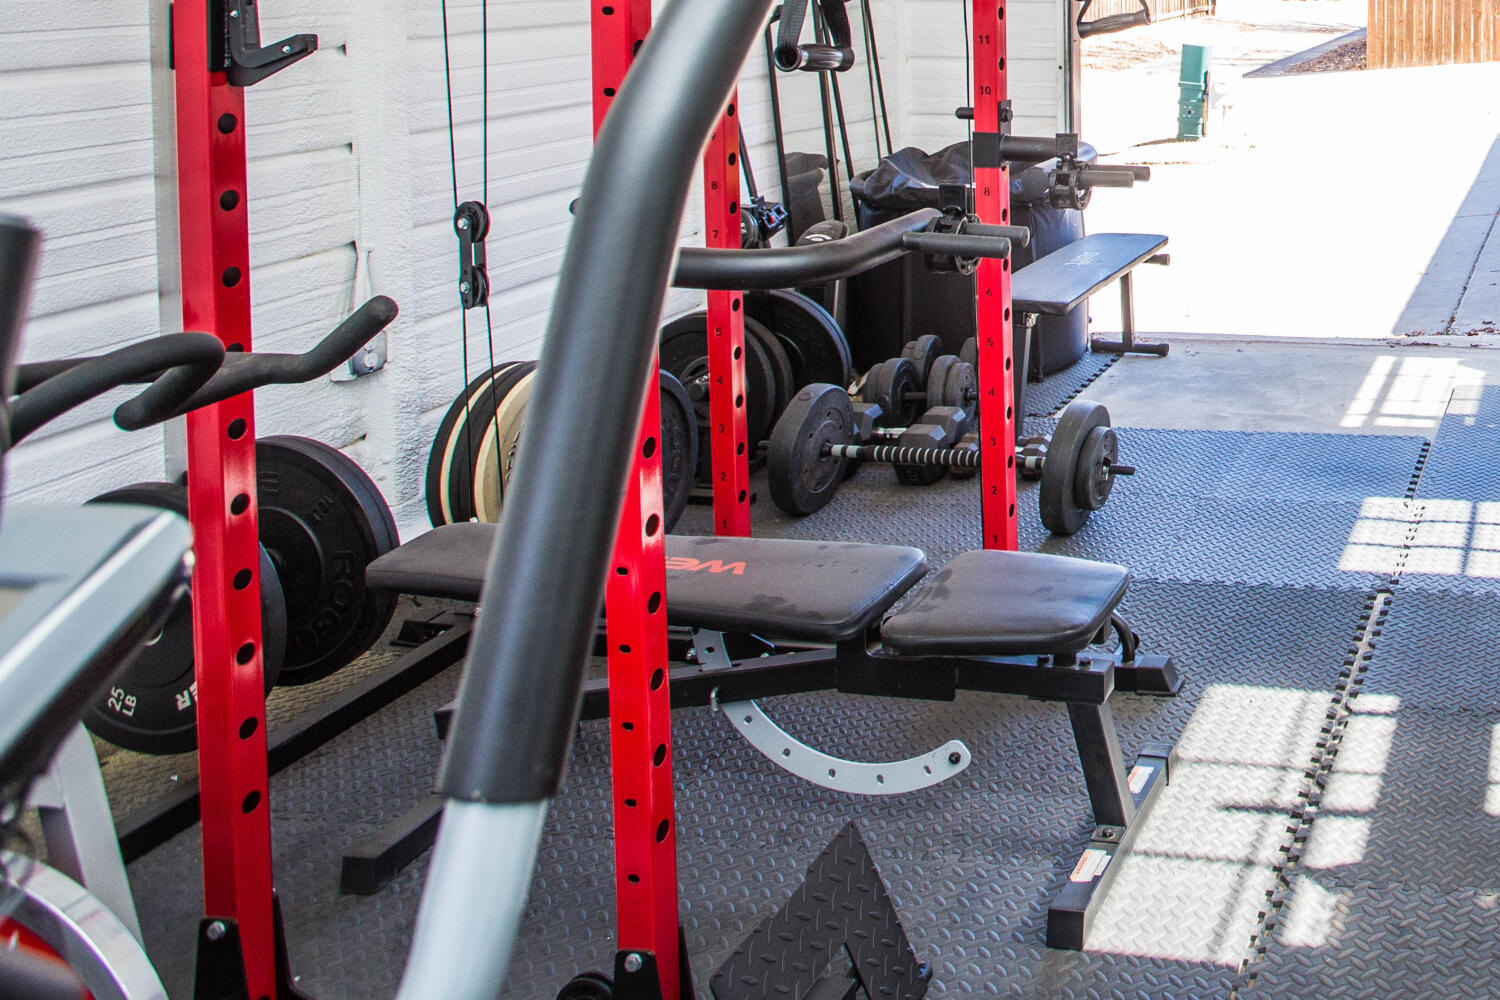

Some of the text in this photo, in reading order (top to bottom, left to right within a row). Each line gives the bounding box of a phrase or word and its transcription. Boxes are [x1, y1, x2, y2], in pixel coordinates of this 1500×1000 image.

[978, 34, 990, 45] 11
[979, 85, 992, 96] 10
[711, 180, 718, 191] 8
[983, 187, 990, 197] 8
[712, 229, 719, 239] 7
[985, 288, 993, 297] 6
[714, 327, 721, 337] 5
[987, 338, 994, 348] 5
[716, 376, 723, 385] 4
[988, 387, 995, 397] 4
[718, 423, 725, 433] 3
[989, 437, 996, 447] 3
[720, 471, 726, 481] 2
[991, 486, 998, 495] 2
[665, 555, 747, 576] WE
[108, 686, 125, 712] 25
[122, 695, 137, 717] LB
